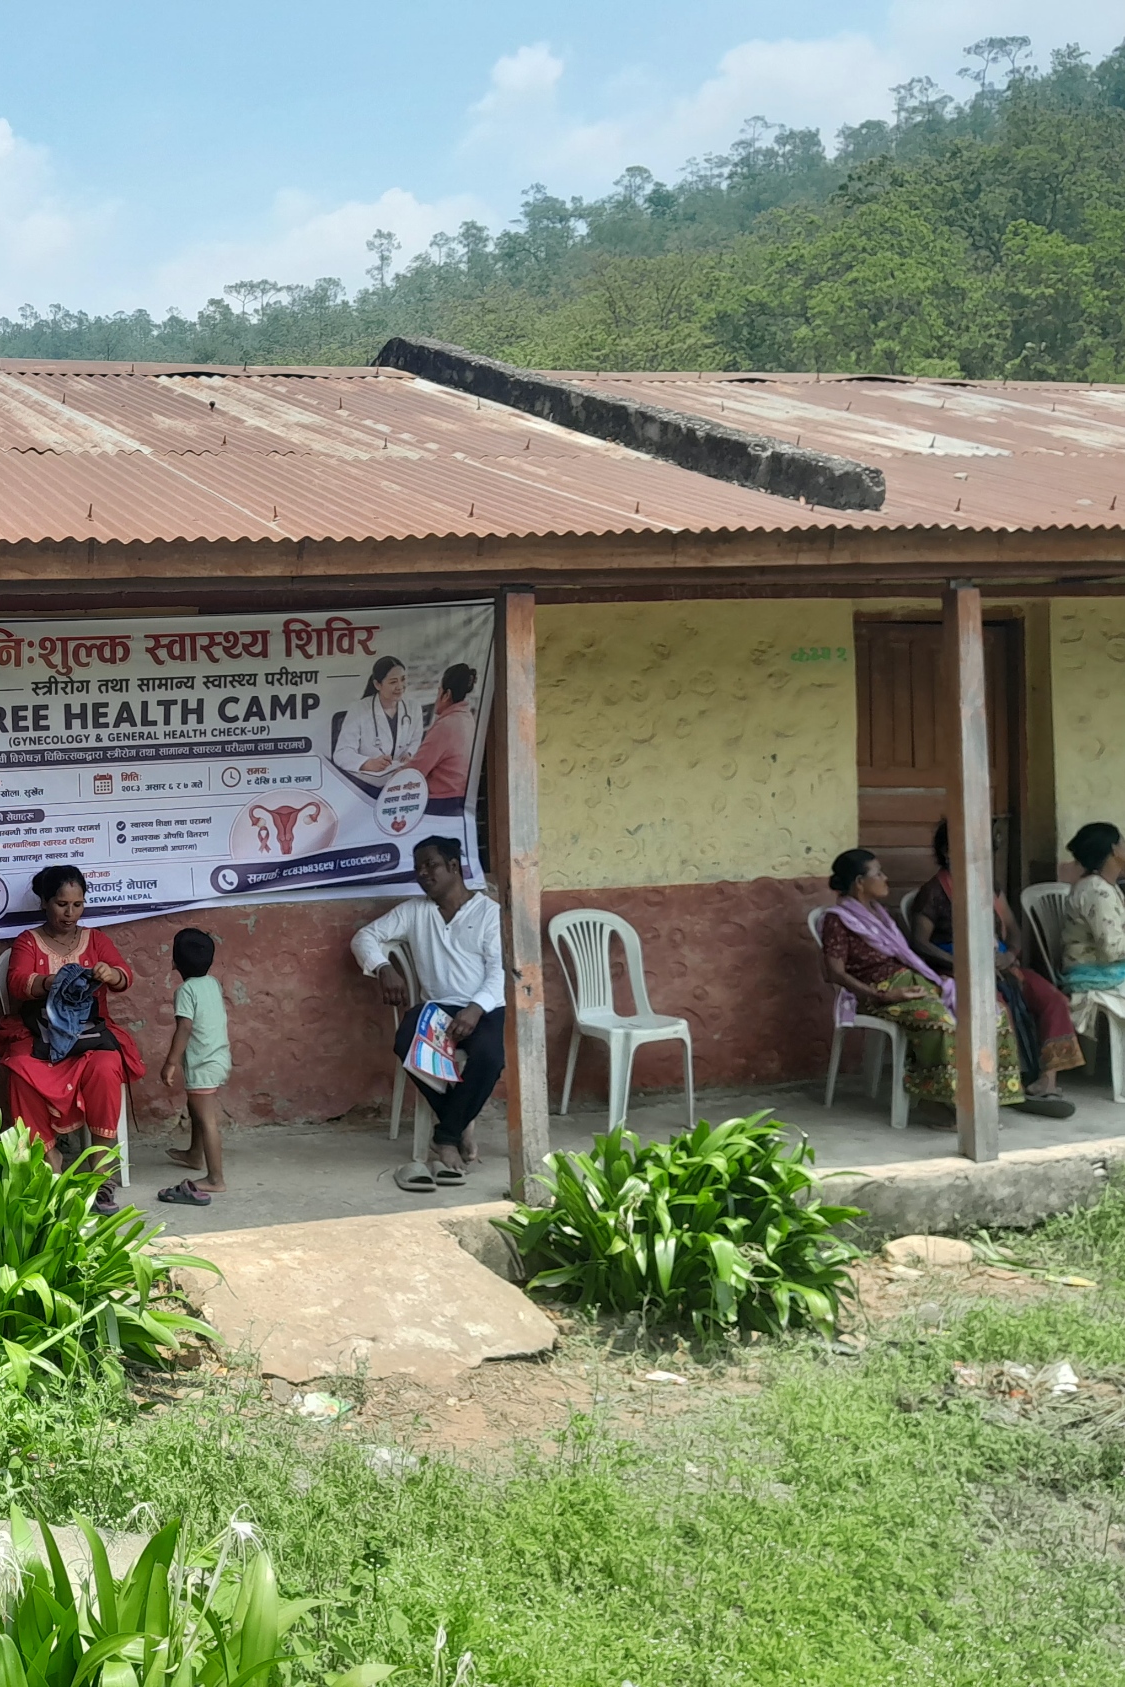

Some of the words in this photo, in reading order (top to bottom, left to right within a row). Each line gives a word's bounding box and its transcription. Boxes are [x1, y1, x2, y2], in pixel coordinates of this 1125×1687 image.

[144, 629, 271, 666] स्वास्थ्य
[283, 617, 380, 660] शिविर
[31, 675, 91, 697] स्त्रीरोग
[97, 678, 130, 694] तथा
[137, 676, 197, 693] सामान्य
[203, 673, 259, 691] स्वास्थ्य
[265, 666, 320, 687] परीक्षण
[64, 698, 205, 731] HEALTH
[218, 692, 321, 724] CAMP
[9, 734, 91, 748] (GYNECOLOGY
[95, 733, 104, 743] &
[108, 731, 160, 742] GENERAL
[163, 728, 207, 740] HEALTH
[211, 725, 271, 737] CHECK-UP)
[10, 753, 42, 764] विशेषज्ञ
[44, 749, 104, 763] चिकित्सकद्वारा
[106, 747, 137, 759] स्त्रीरोग
[139, 748, 156, 757] तथा
[159, 746, 190, 757] सामान्य
[192, 745, 222, 755] स्वास्थ्य
[225, 742, 255, 753] परीक्षण
[257, 742, 275, 751] तथा
[277, 739, 306, 750] परामर्श
[145, 783, 166, 791] असार
[191, 779, 203, 788] गते
[254, 776, 270, 785] देखि
[43, 839, 67, 847] स्वास्थ्य
[45, 852, 68, 860] स्वास्थ्य
[126, 878, 158, 890] नेपाल
[89, 895, 125, 904] SEWAKAI
[127, 893, 152, 901] NEPAL
